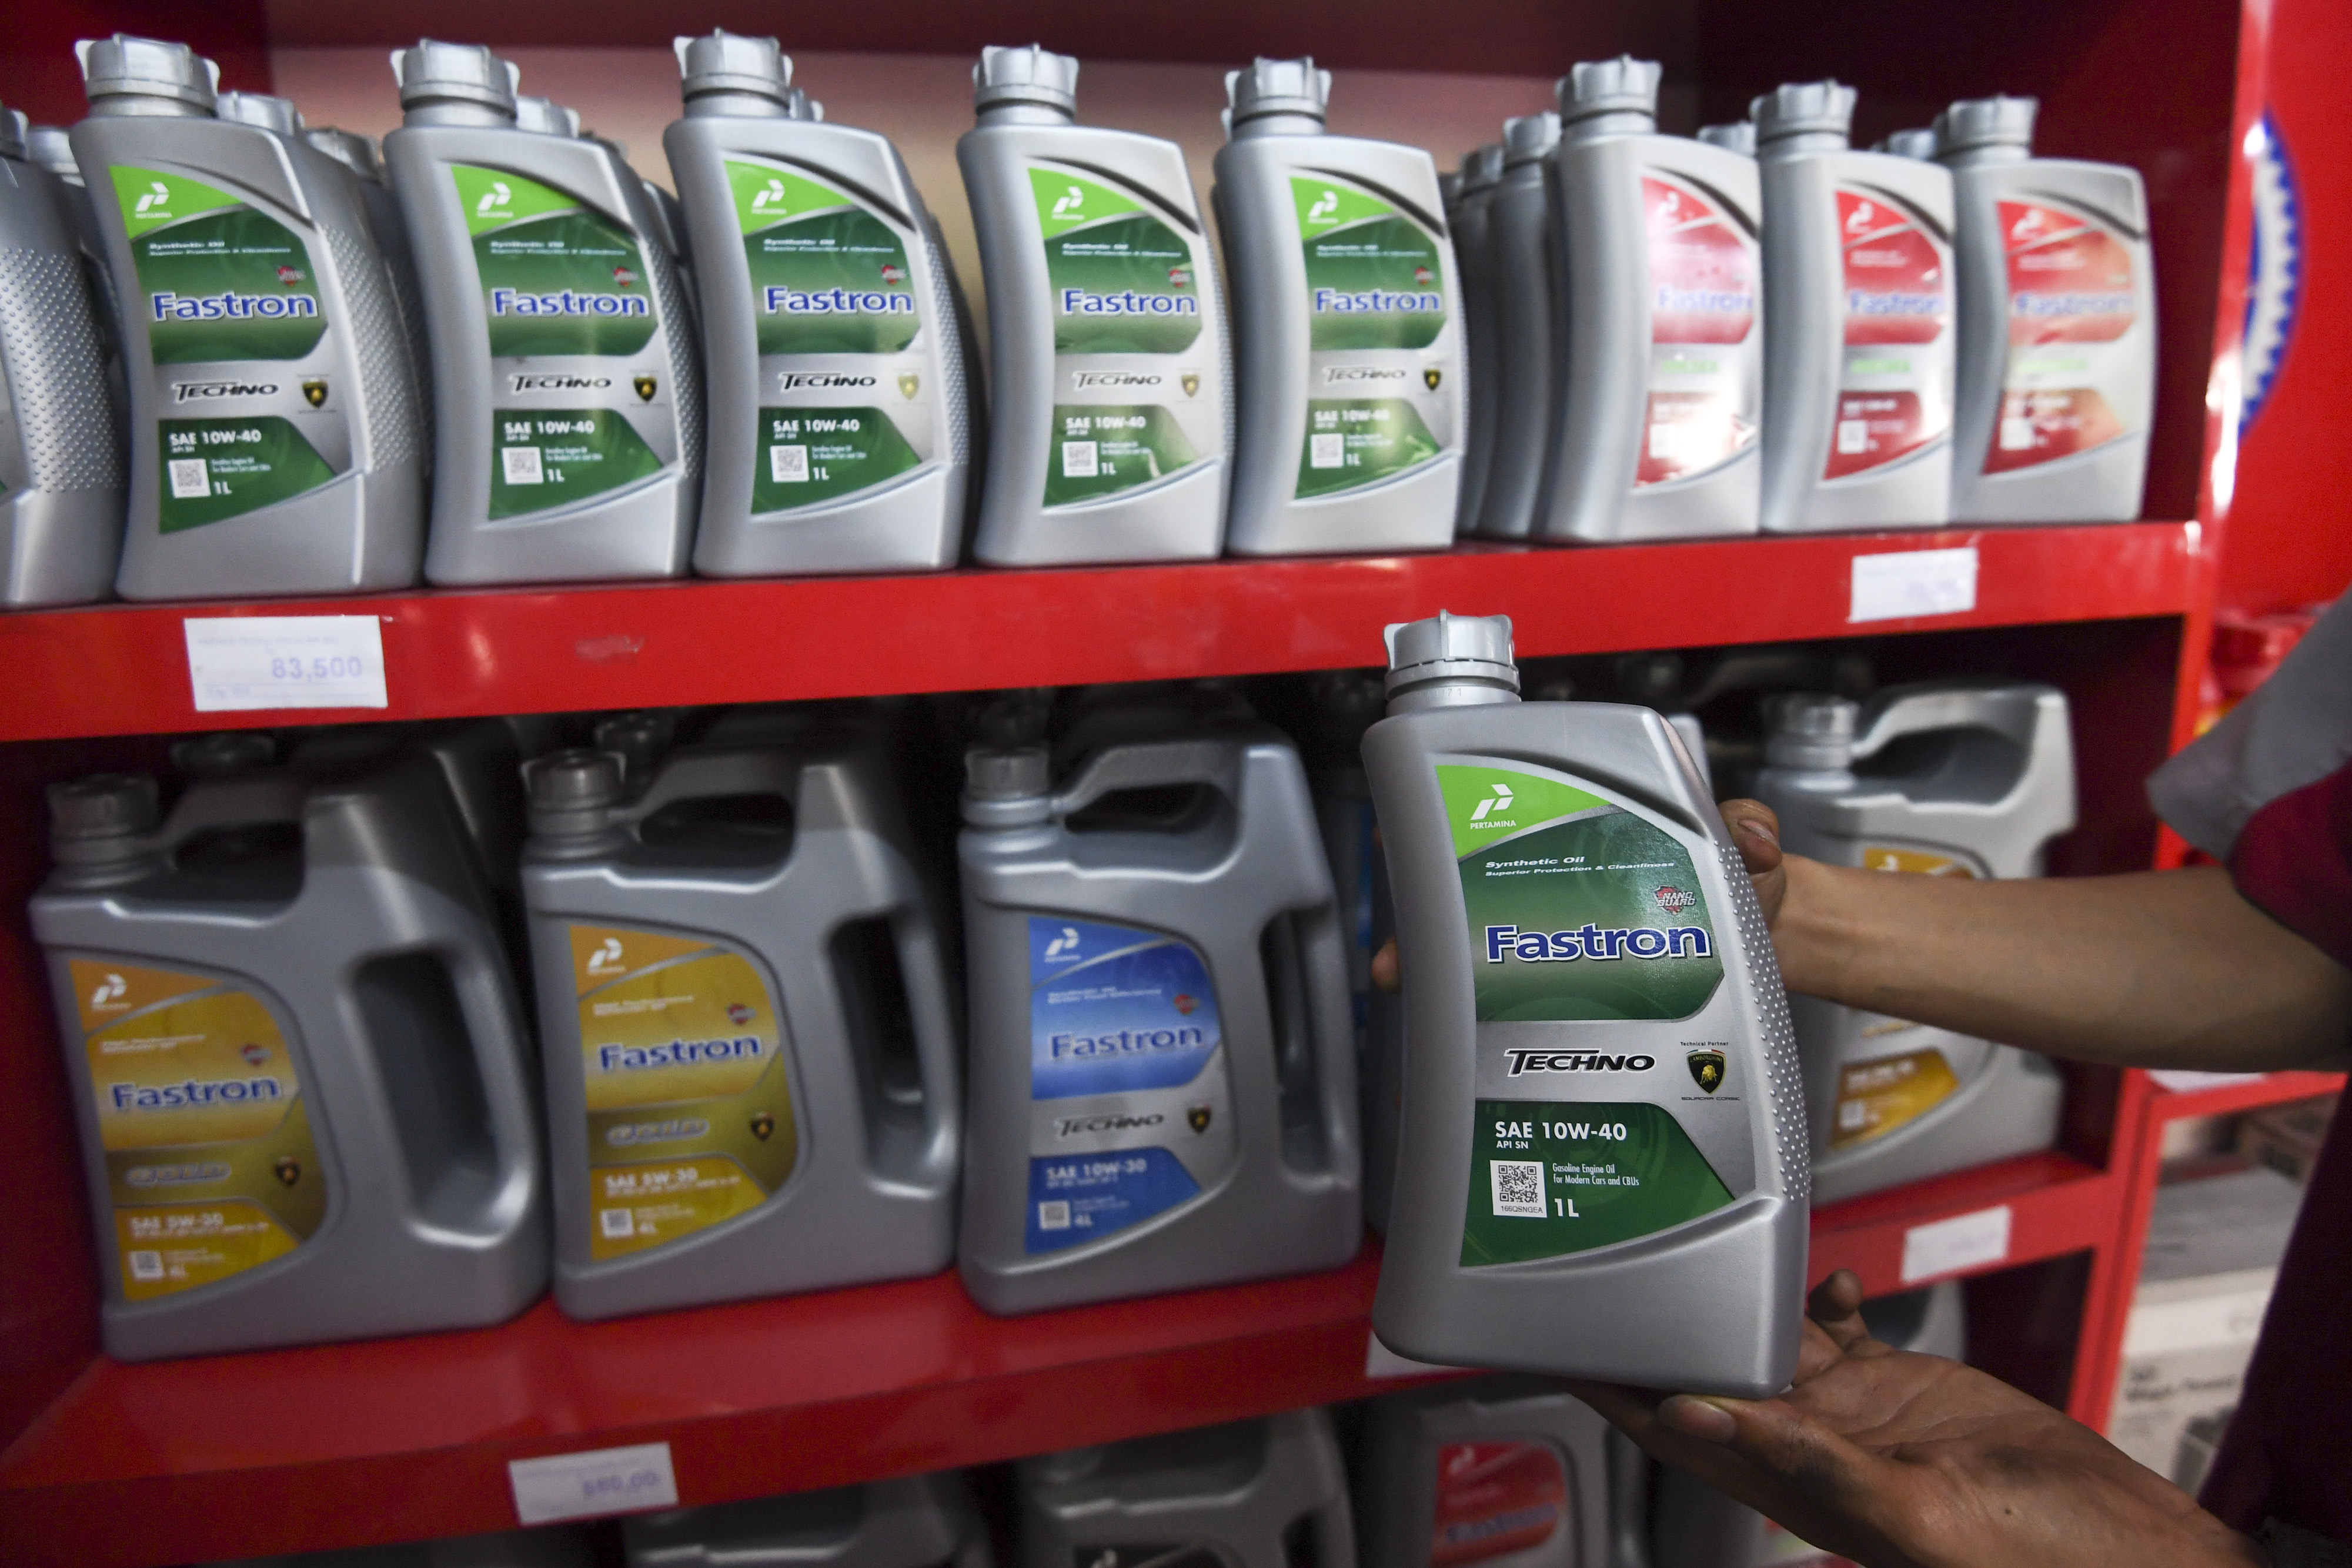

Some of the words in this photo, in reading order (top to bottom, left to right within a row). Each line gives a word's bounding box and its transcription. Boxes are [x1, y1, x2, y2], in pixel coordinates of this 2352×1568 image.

[152, 291, 318, 322] Fastron
[491, 287, 649, 318] Fastron
[764, 286, 914, 315] Fastron
[1061, 288, 1198, 316] Fastron
[1315, 288, 1440, 313] Fastron
[509, 373, 612, 393] TECHNO
[780, 372, 876, 392] TECHNO
[1073, 372, 1161, 389] TECHNO
[172, 381, 279, 403] TECHNO
[505, 422, 532, 433] SAE
[537, 420, 595, 434] 10W-40
[773, 420, 800, 432] SAE
[805, 419, 860, 432] 10W-40
[1066, 417, 1091, 429] SAE
[1095, 416, 1146, 429] 10W-40
[169, 432, 196, 445] SAE
[202, 429, 262, 444] 10W-40
[547, 469, 564, 482] 1L
[813, 467, 830, 480] 1L
[214, 482, 232, 494] 1L
[271, 657, 363, 682] 83,500
[1470, 820, 1516, 830] PERTAMINA
[1485, 858, 1558, 868] Synthetic
[1658, 898, 1696, 907] GUARD
[1663, 891, 1693, 900] NANO
[1484, 922, 1712, 962] Fastron
[1048, 1025, 1203, 1059] Fastron
[598, 1035, 761, 1070] Fastron
[1504, 1048, 1656, 1077] TECHNO
[109, 1076, 282, 1110] Fastron
[1495, 1121, 1533, 1139] SAE
[1542, 1122, 1627, 1141] 10W-40
[1552, 1163, 1580, 1173] Gasoline
[1582, 1164, 1604, 1175] Engine
[1606, 1164, 1615, 1174] Oil
[1553, 1175, 1562, 1183] for
[1565, 1175, 1590, 1185] Modern
[1592, 1176, 1606, 1185] Cars
[1608, 1176, 1620, 1185] and
[1622, 1176, 1639, 1186] CBUs
[1554, 1198, 1579, 1218] 1L
